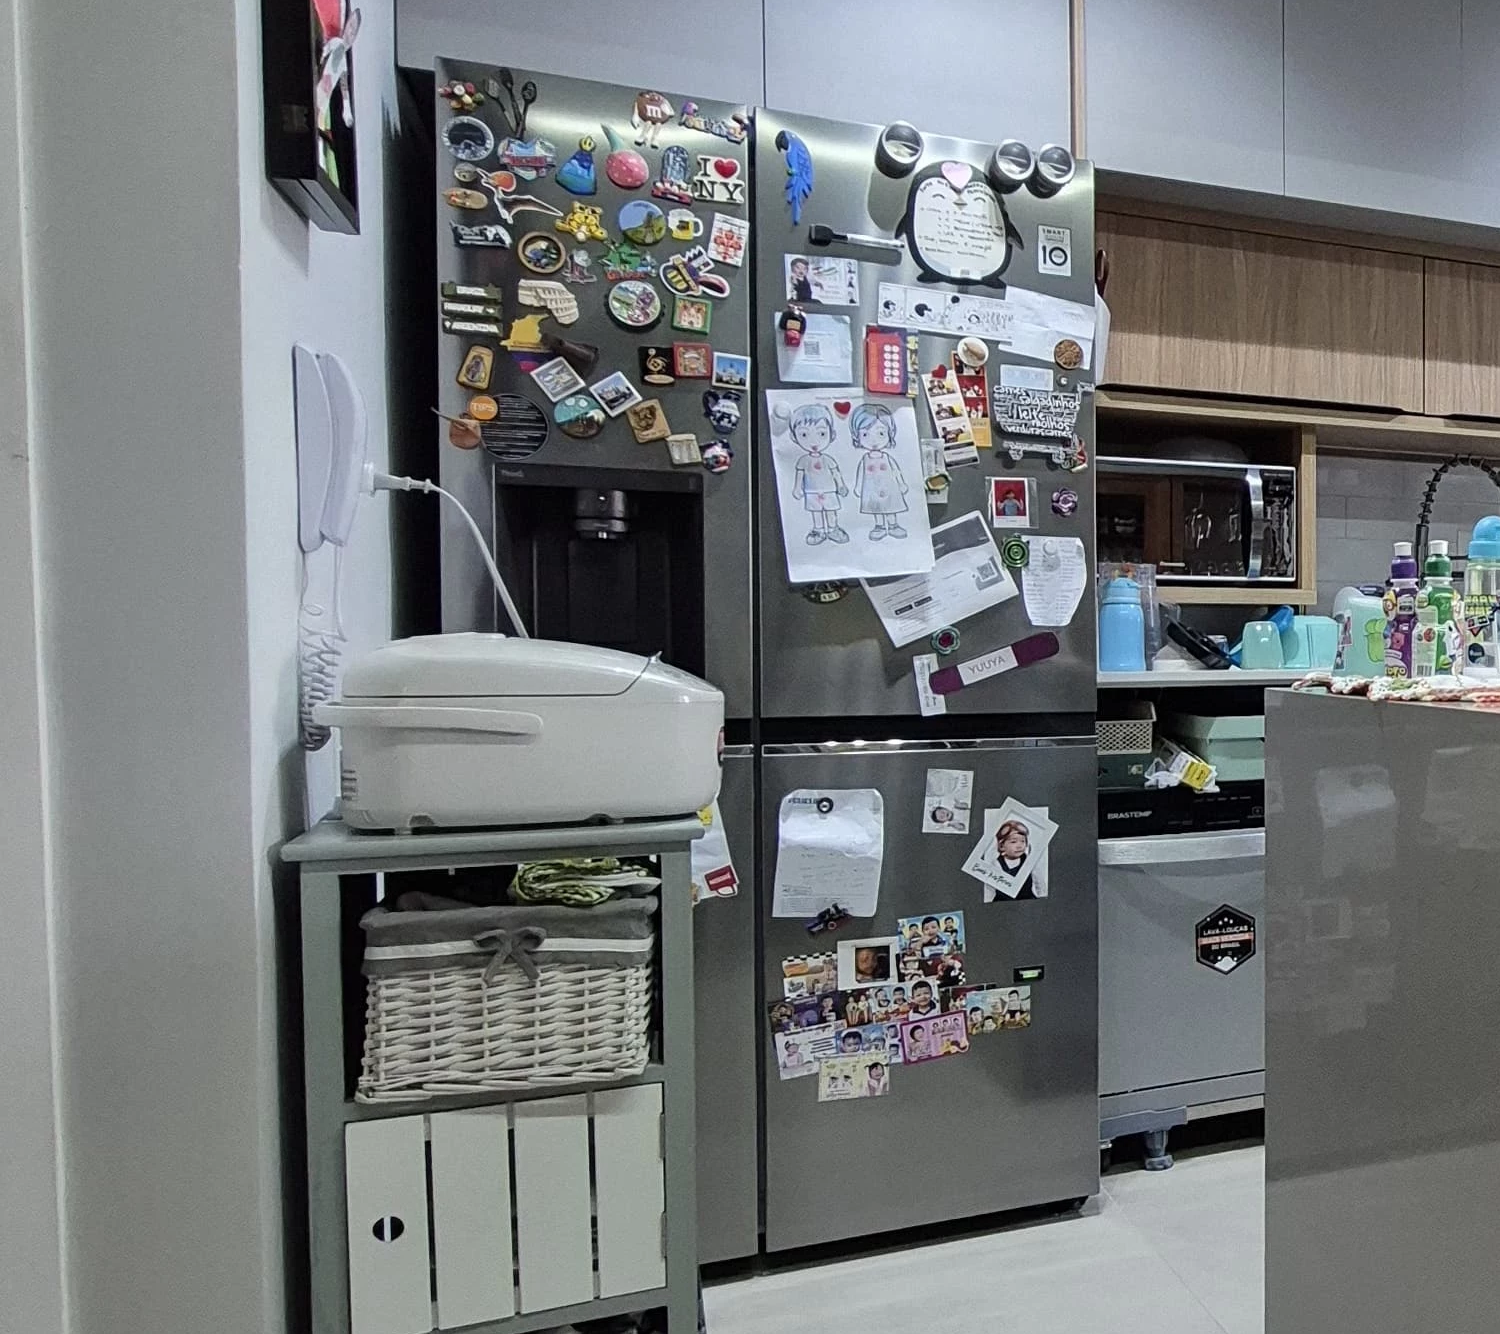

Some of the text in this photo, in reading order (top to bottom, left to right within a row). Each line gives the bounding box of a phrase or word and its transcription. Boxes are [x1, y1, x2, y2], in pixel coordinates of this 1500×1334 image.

[698, 158, 711, 176] I
[697, 179, 743, 202] NY
[1042, 245, 1068, 266] 10
[968, 656, 1006, 674] YUUYA
[1107, 811, 1153, 820] BRASTEMP
